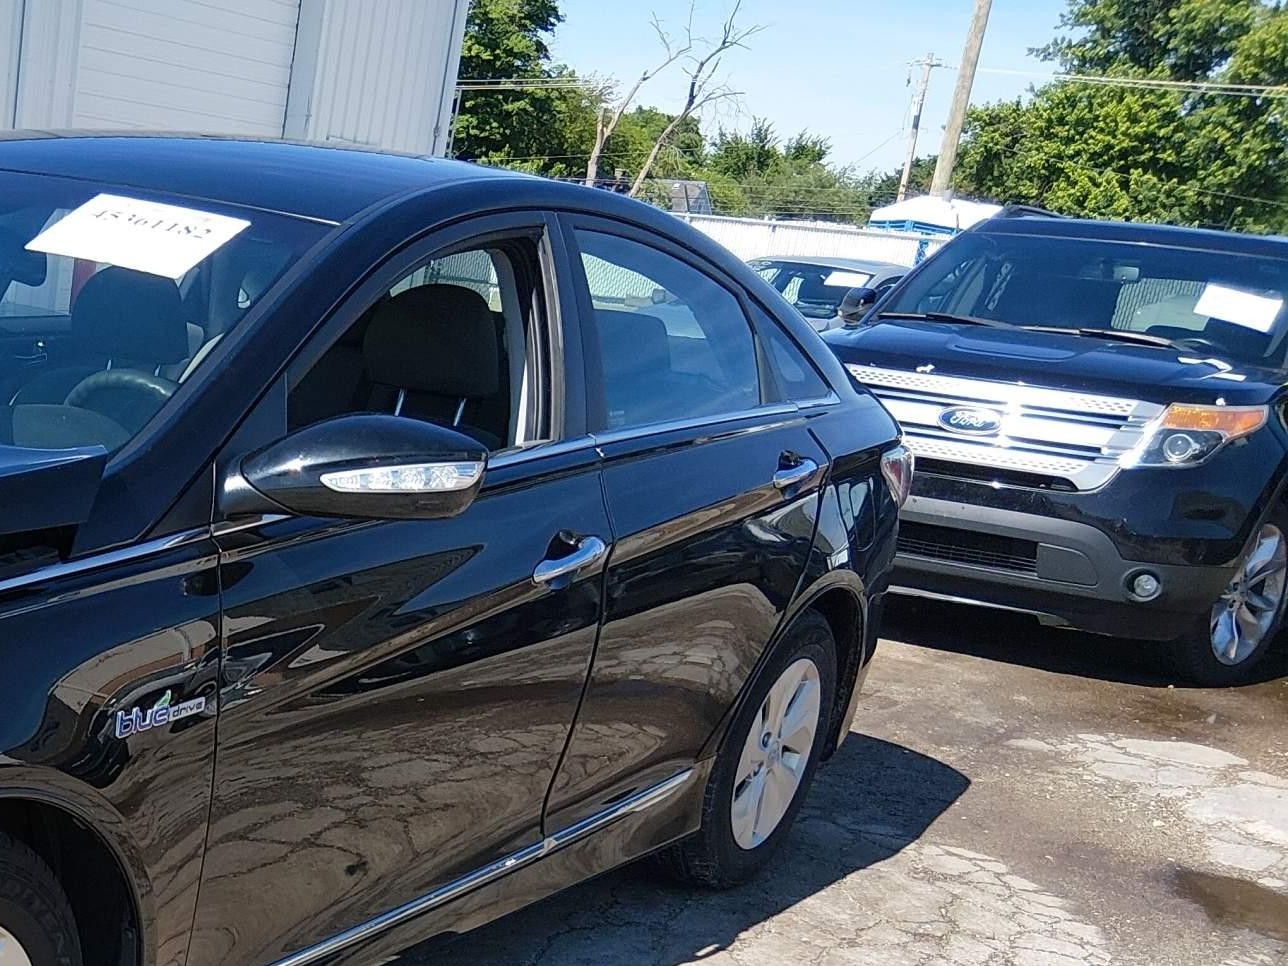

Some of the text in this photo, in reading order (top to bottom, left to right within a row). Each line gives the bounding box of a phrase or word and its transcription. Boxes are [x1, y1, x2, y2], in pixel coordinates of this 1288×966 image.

[949, 410, 988, 428] Ford
[115, 700, 204, 739] blue drive
